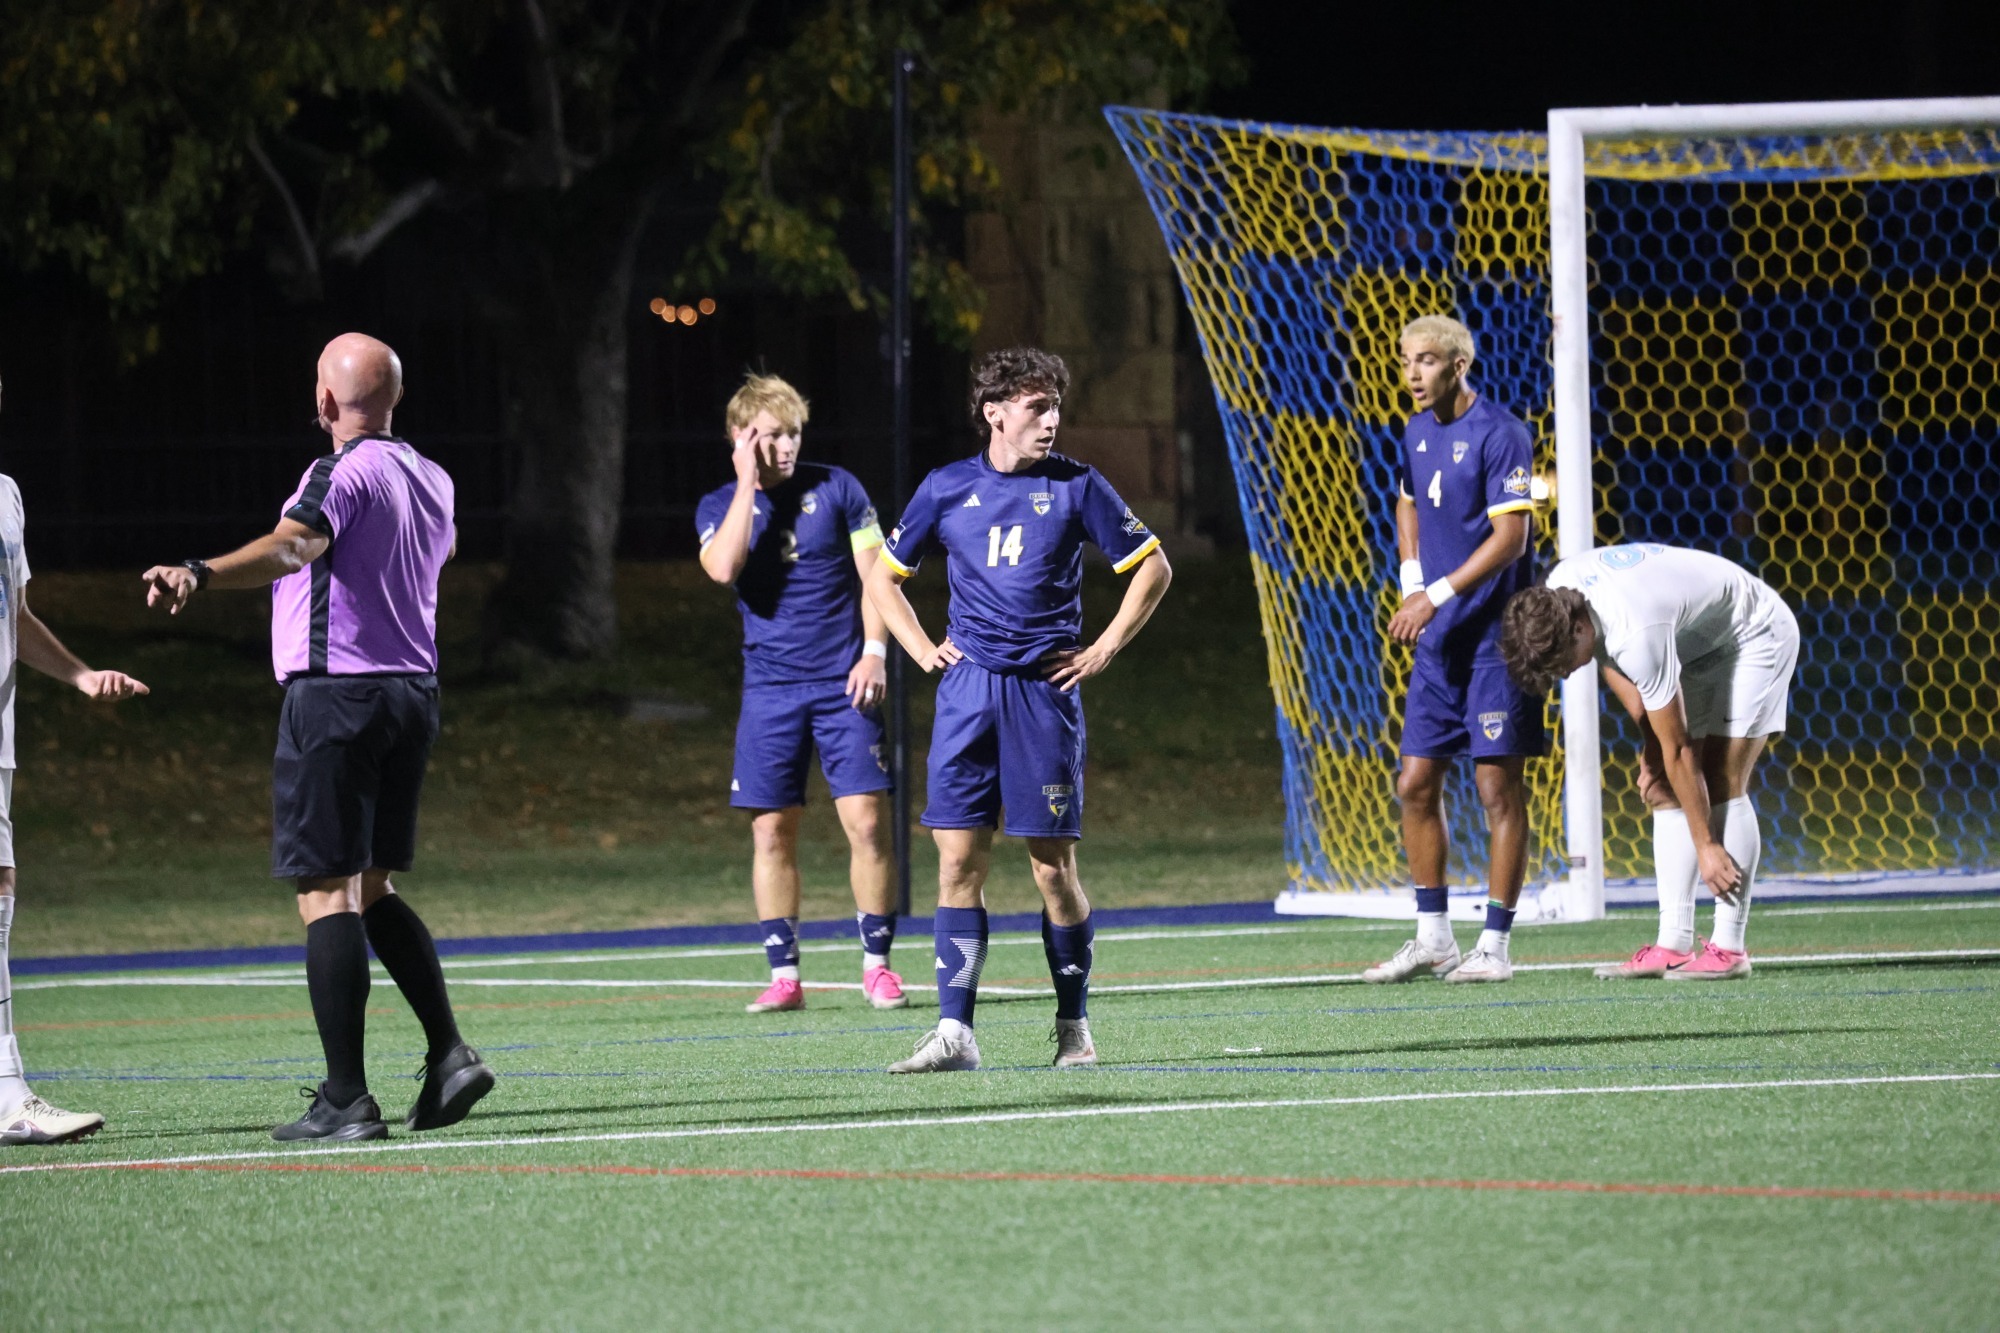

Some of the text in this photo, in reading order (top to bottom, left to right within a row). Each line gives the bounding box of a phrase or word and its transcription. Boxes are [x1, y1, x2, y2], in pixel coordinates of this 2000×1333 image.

[1427, 470, 1443, 508] 4
[781, 529, 799, 563] 2
[986, 525, 1024, 567] 14
